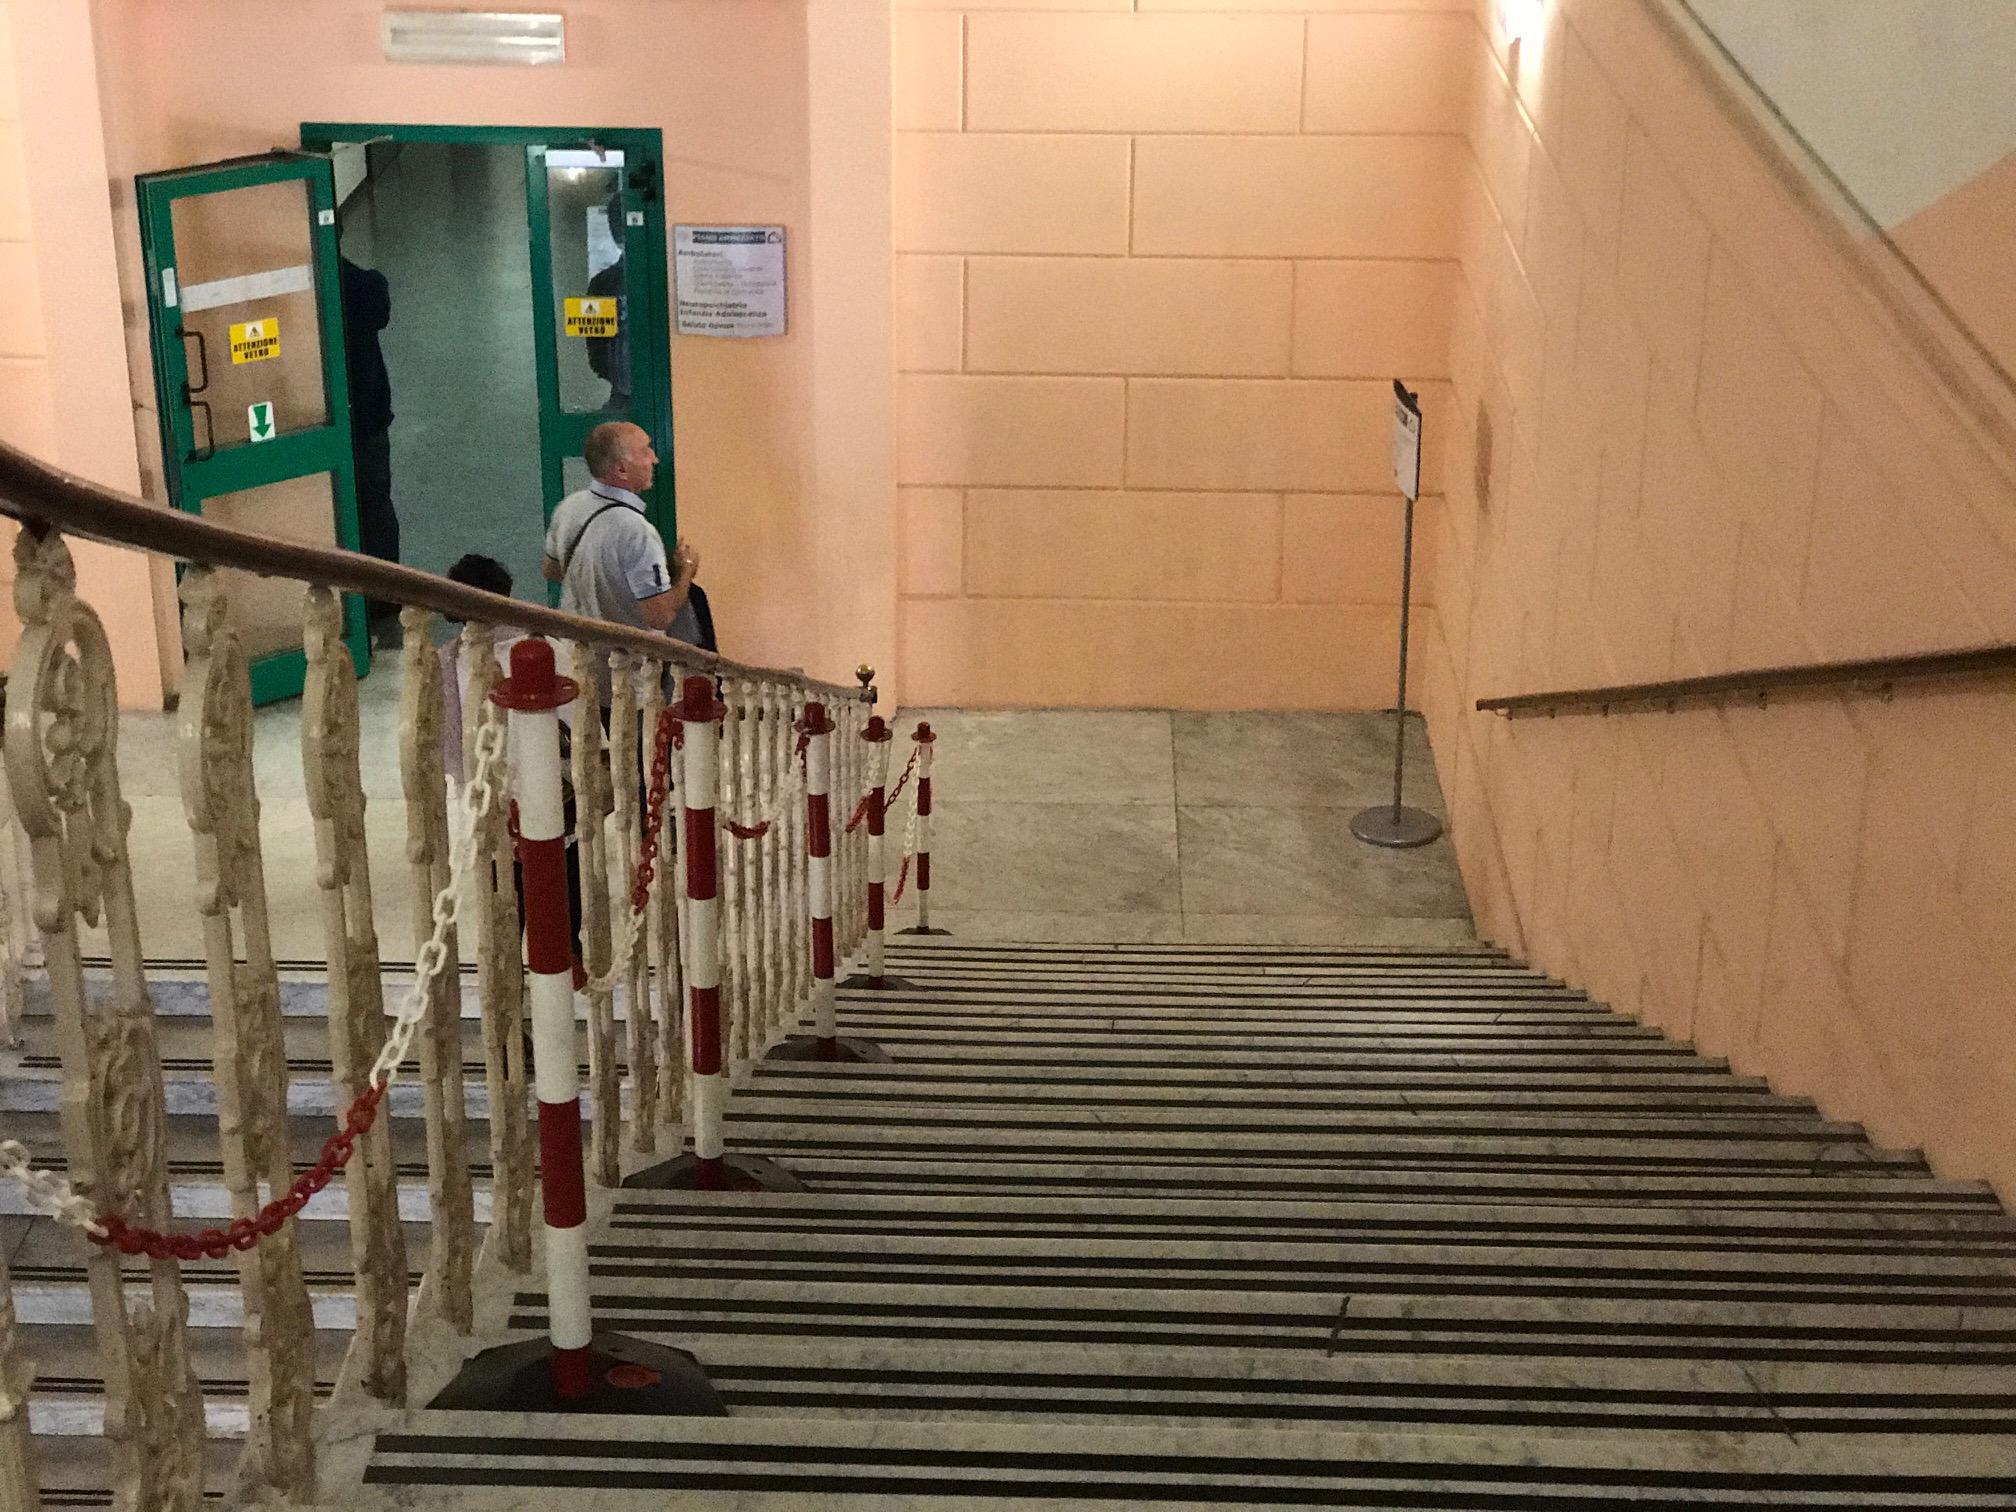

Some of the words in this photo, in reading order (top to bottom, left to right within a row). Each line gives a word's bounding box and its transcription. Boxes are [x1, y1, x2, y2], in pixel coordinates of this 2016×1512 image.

[567, 317, 615, 326] ATTENZIONE
[579, 326, 605, 335] VETRO
[233, 337, 277, 352] ATTENZIONE
[244, 348, 269, 359] VETRO
